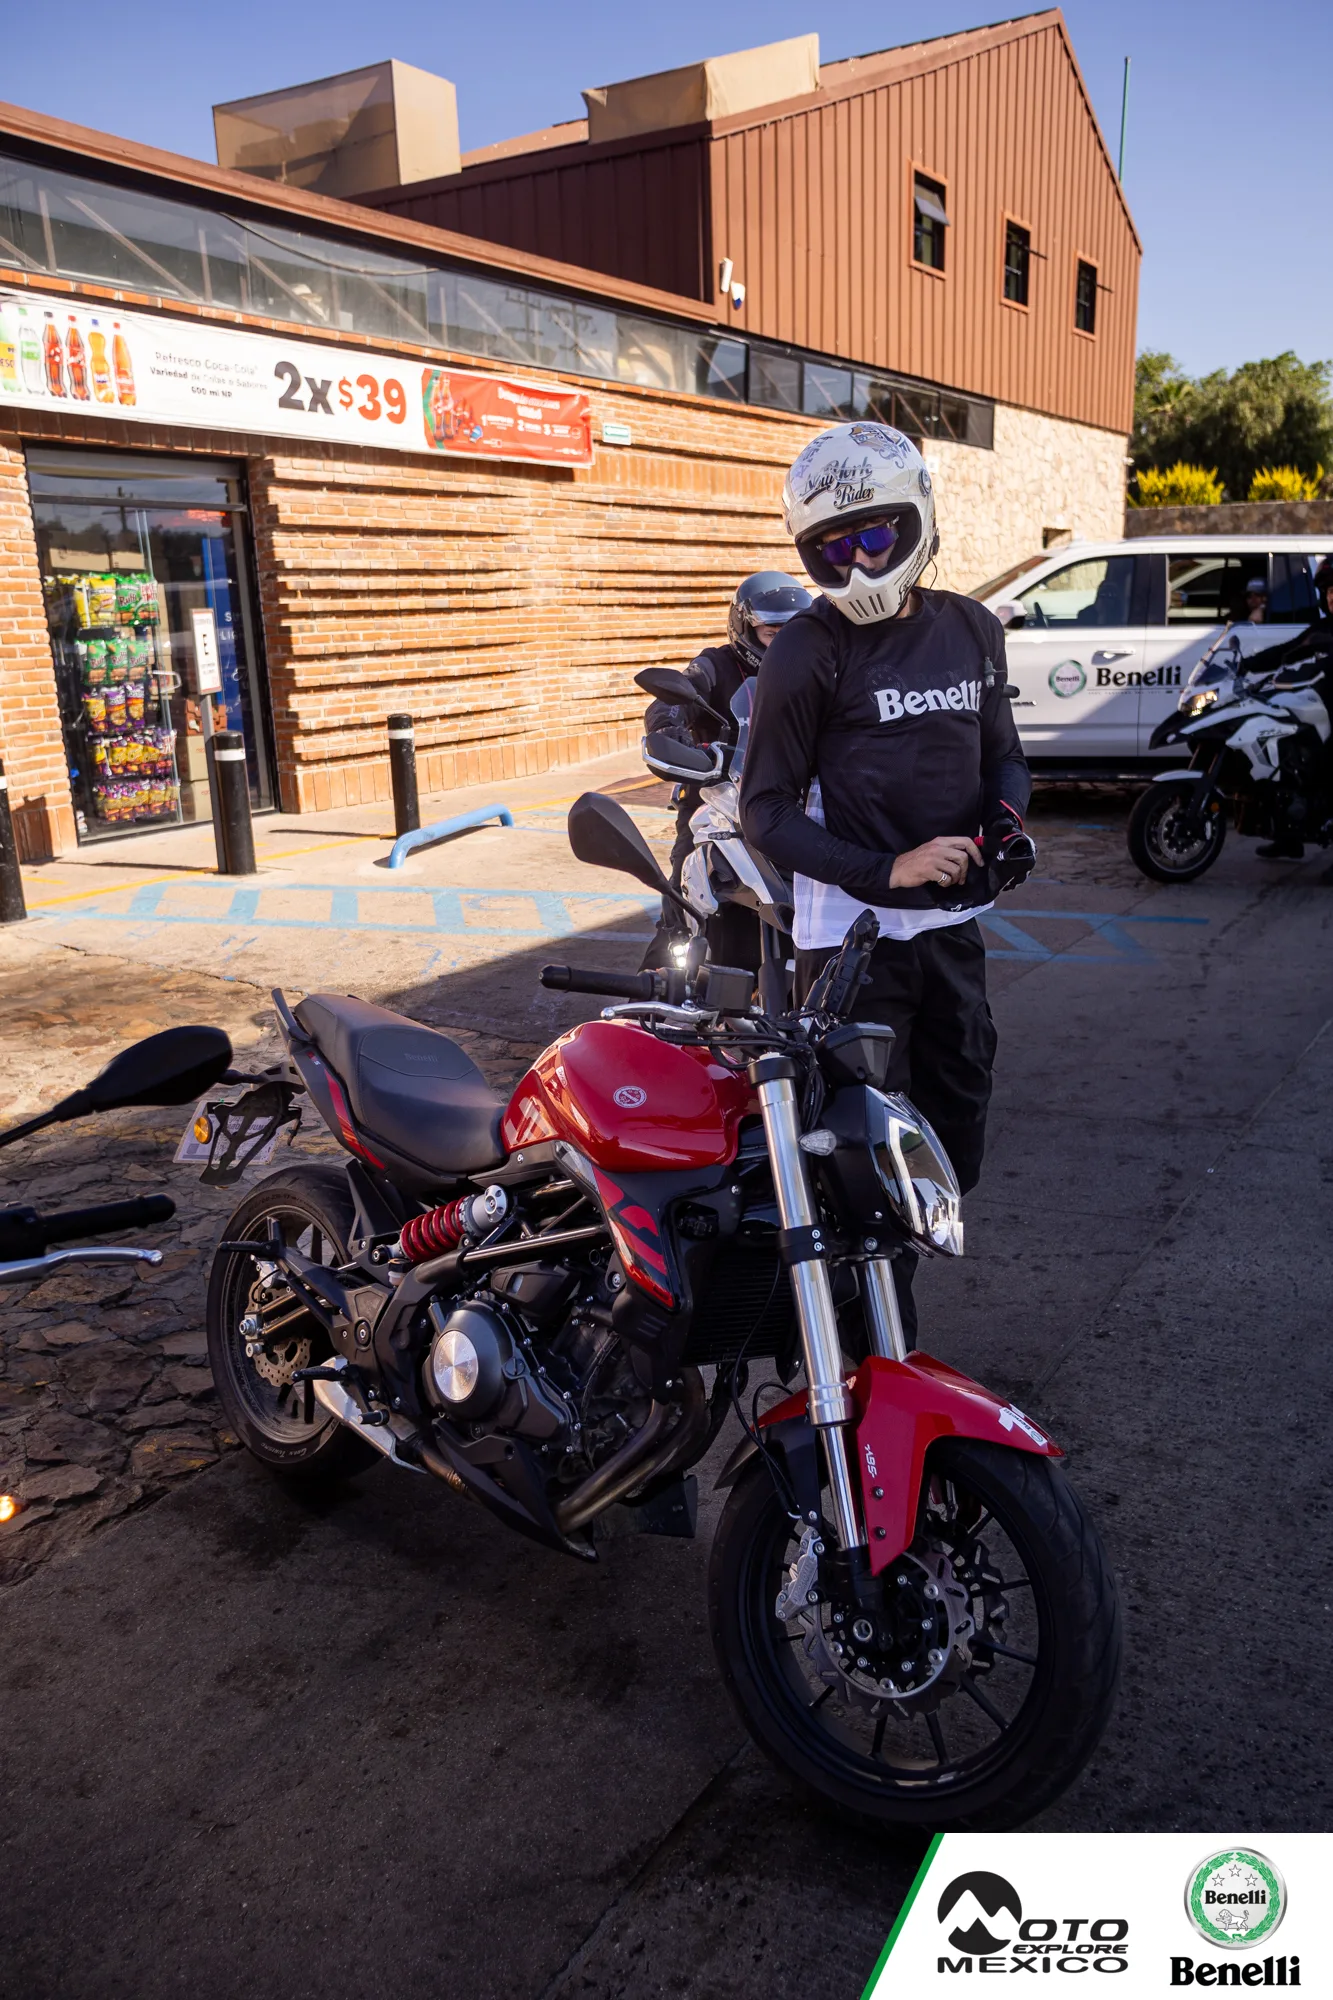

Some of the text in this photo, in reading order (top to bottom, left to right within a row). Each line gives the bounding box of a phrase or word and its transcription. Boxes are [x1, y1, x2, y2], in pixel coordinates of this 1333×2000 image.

[150, 366, 188, 379] Variedad
[833, 483, 875, 509] Rider
[1055, 675, 1080, 683] Benelli
[1096, 666, 1182, 688] Benelli
[874, 680, 983, 723] Benelli
[864, 1444, 878, 1478] ABS
